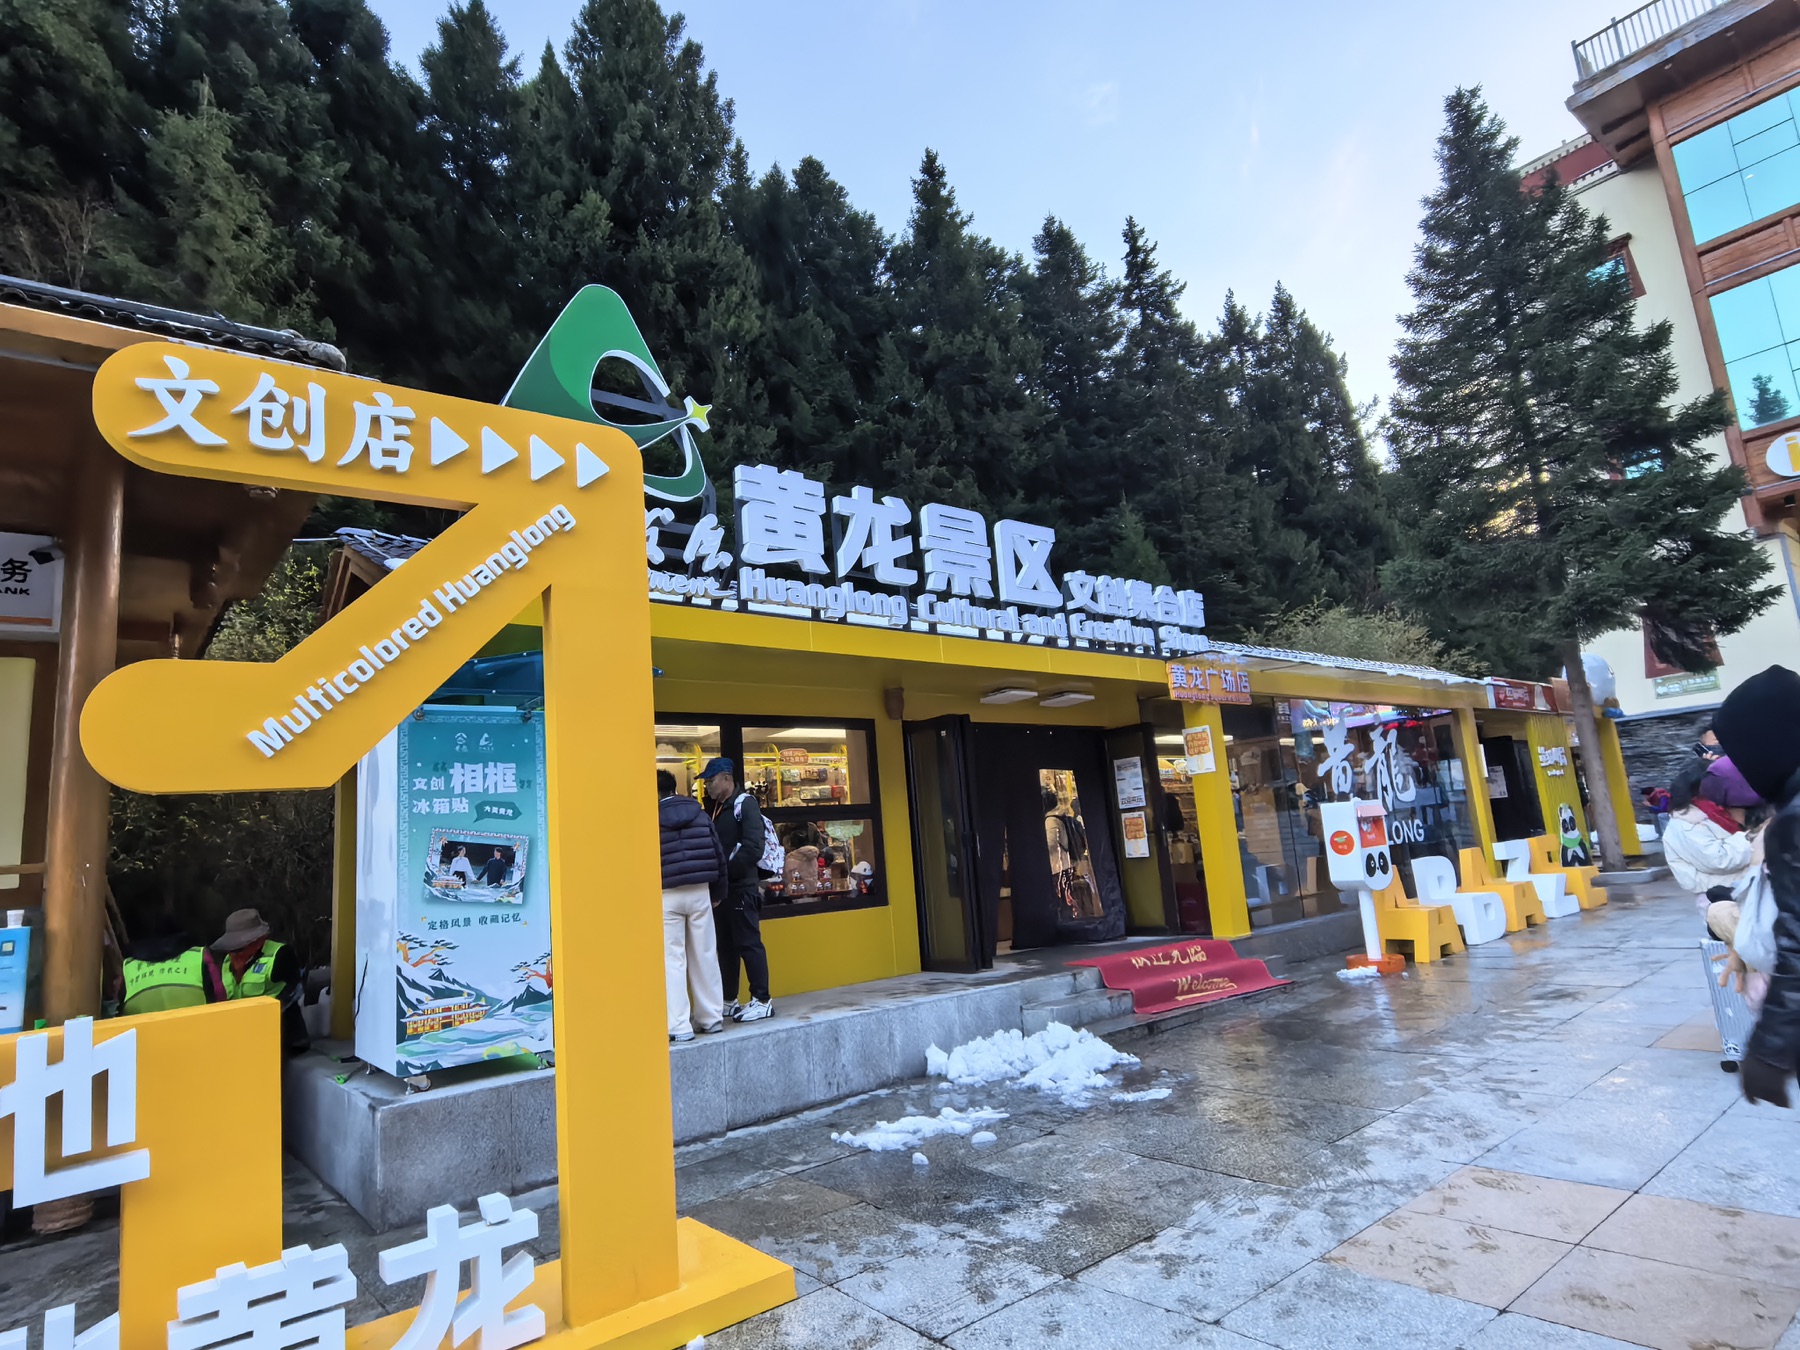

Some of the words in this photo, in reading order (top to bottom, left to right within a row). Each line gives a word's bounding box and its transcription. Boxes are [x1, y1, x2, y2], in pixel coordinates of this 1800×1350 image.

[127, 355, 416, 473] 文创店
[734, 463, 1064, 608] 黄龙景区
[739, 567, 909, 626] Huanglong
[917, 593, 1020, 633] Cultural
[1020, 613, 1068, 639] and
[1069, 612, 1156, 648] Creative
[1063, 569, 1206, 629] 文创集合店
[246, 598, 443, 758] Multicolored
[432, 503, 577, 613] Huanglong
[1171, 664, 1251, 692] 黄龙广场店
[412, 776, 445, 791] 文创
[412, 797, 469, 815] 冰箱贴
[427, 916, 472, 931] 定格风景
[478, 912, 522, 926] 收藏记忆
